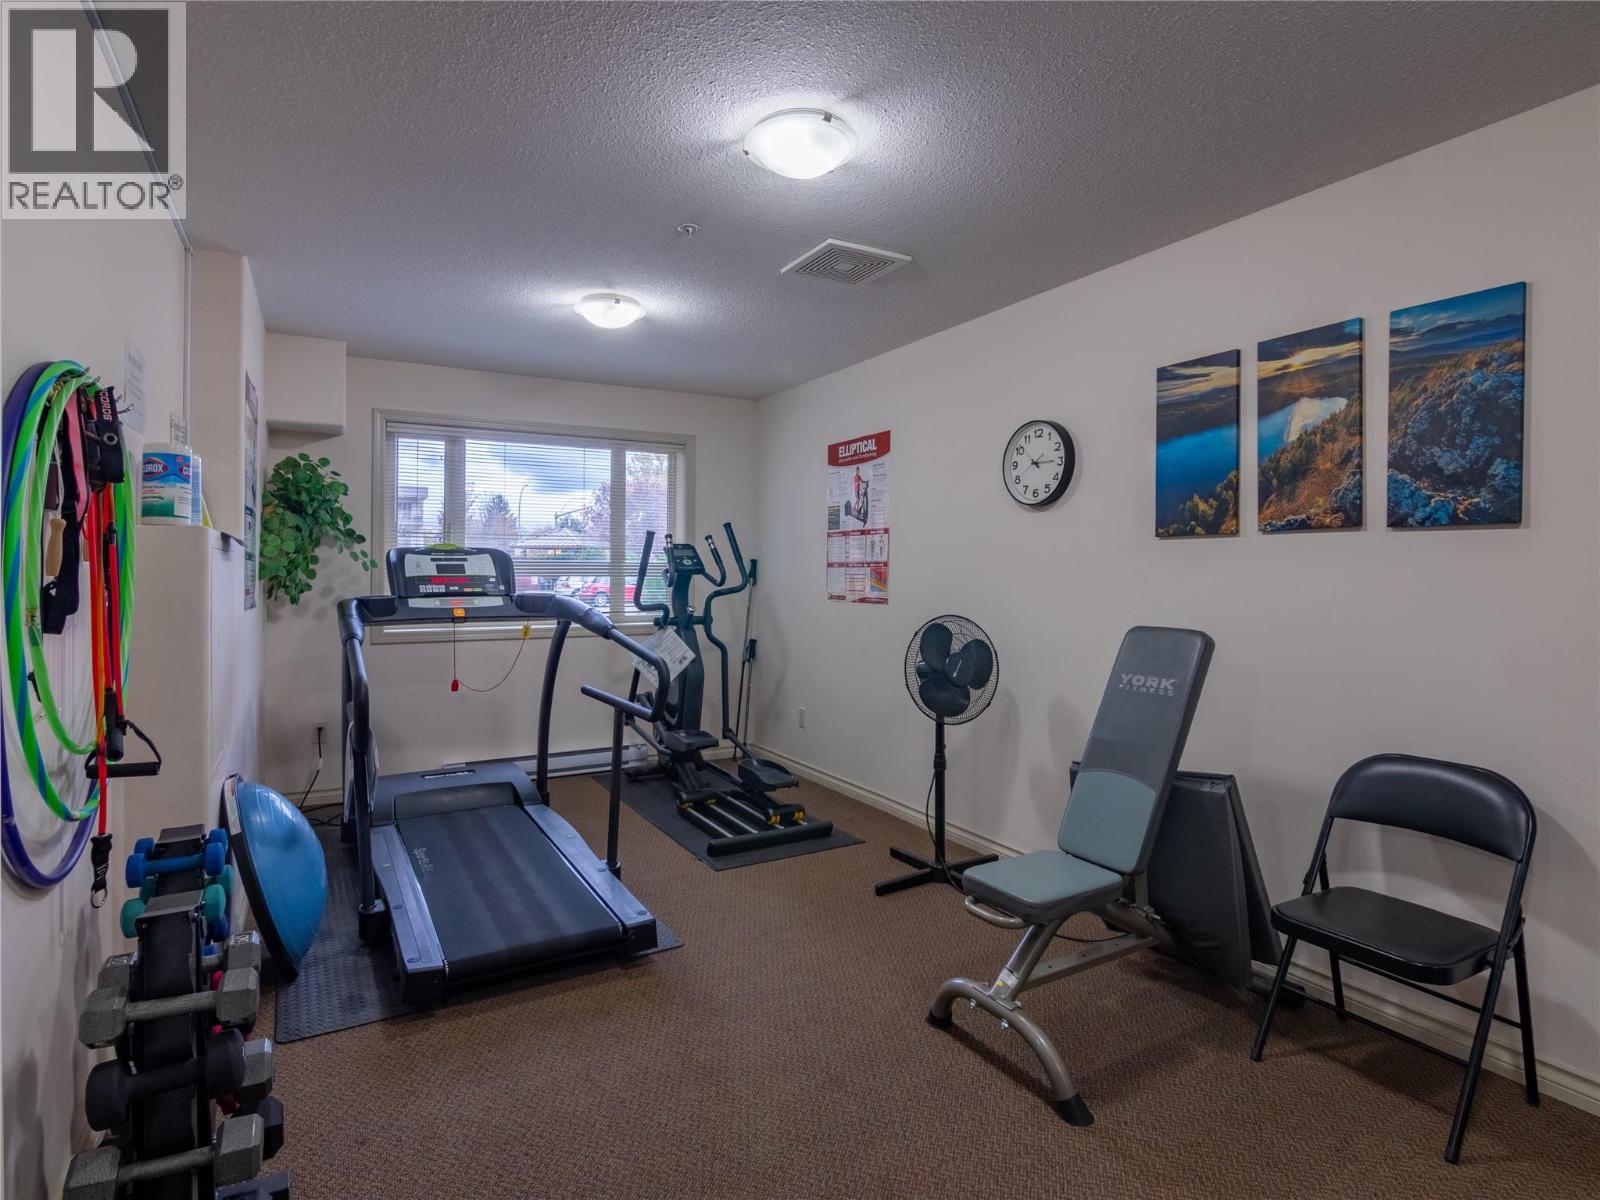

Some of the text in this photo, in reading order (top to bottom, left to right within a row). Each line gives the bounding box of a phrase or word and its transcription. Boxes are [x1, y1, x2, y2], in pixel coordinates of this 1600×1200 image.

[1034, 428, 1044, 438] 12
[1048, 431, 1052, 441] 1
[1024, 434, 1031, 444] 11
[838, 438, 878, 458] ELLIPTICAL
[1015, 444, 1025, 456] 10
[1054, 441, 1062, 452] 2
[1012, 460, 1019, 470] 9
[1057, 456, 1064, 467] 3
[1014, 475, 1021, 485] 8
[1052, 472, 1060, 482] 4
[1022, 485, 1029, 495] 7
[1032, 488, 1039, 498] 6
[1044, 483, 1051, 494] 5
[1121, 673, 1177, 690] YORK
[1119, 683, 1177, 697] FITNESS
